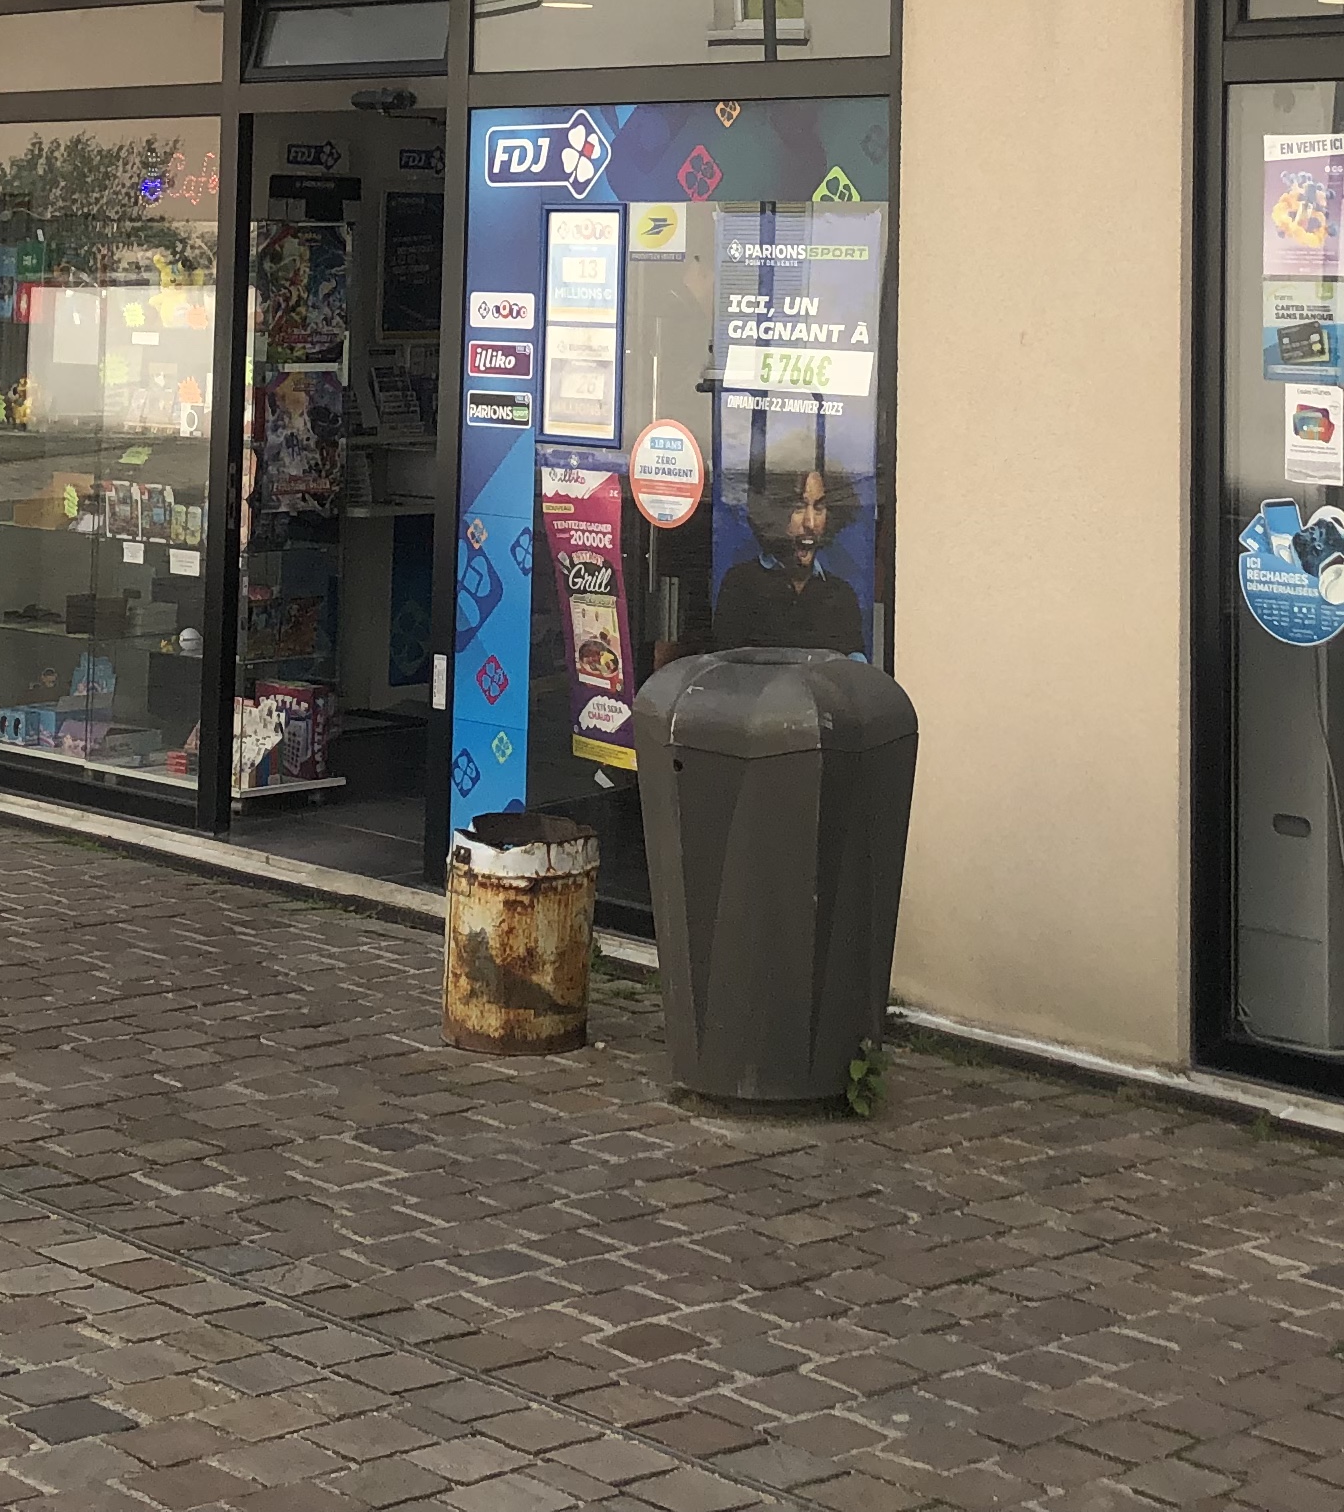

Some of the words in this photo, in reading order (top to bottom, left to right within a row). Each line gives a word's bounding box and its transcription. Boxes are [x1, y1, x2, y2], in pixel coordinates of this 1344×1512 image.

[289, 147, 316, 162] FDJ
[1280, 142, 1294, 155] EN
[1296, 139, 1328, 154] VENTE
[1330, 138, 1343, 150] ICI
[400, 152, 426, 167] FDJ
[492, 137, 551, 174] FDJ
[573, 219, 613, 240] LOTO
[745, 244, 806, 259] PARIONS
[808, 247, 867, 259] SPORT
[578, 259, 598, 280] 13
[492, 299, 528, 319] LOTO
[727, 295, 775, 317] ICI,
[783, 296, 819, 316] UN
[728, 320, 845, 343] GAGNANT
[850, 322, 869, 344] À
[474, 348, 516, 371] illiko
[469, 404, 513, 420] PARIONS
[727, 395, 771, 410] DIMANCHE
[771, 397, 783, 411] 22
[783, 398, 820, 414] JANVIER
[820, 402, 844, 416] 2023
[665, 440, 682, 450] ANS
[655, 454, 677, 466] ZÉRO
[639, 464, 653, 475] JEU
[654, 466, 694, 478] D'ARGENT
[1246, 557, 1261, 569] ICI
[568, 565, 612, 592] Grill
[1246, 569, 1309, 585] RECHARGES
